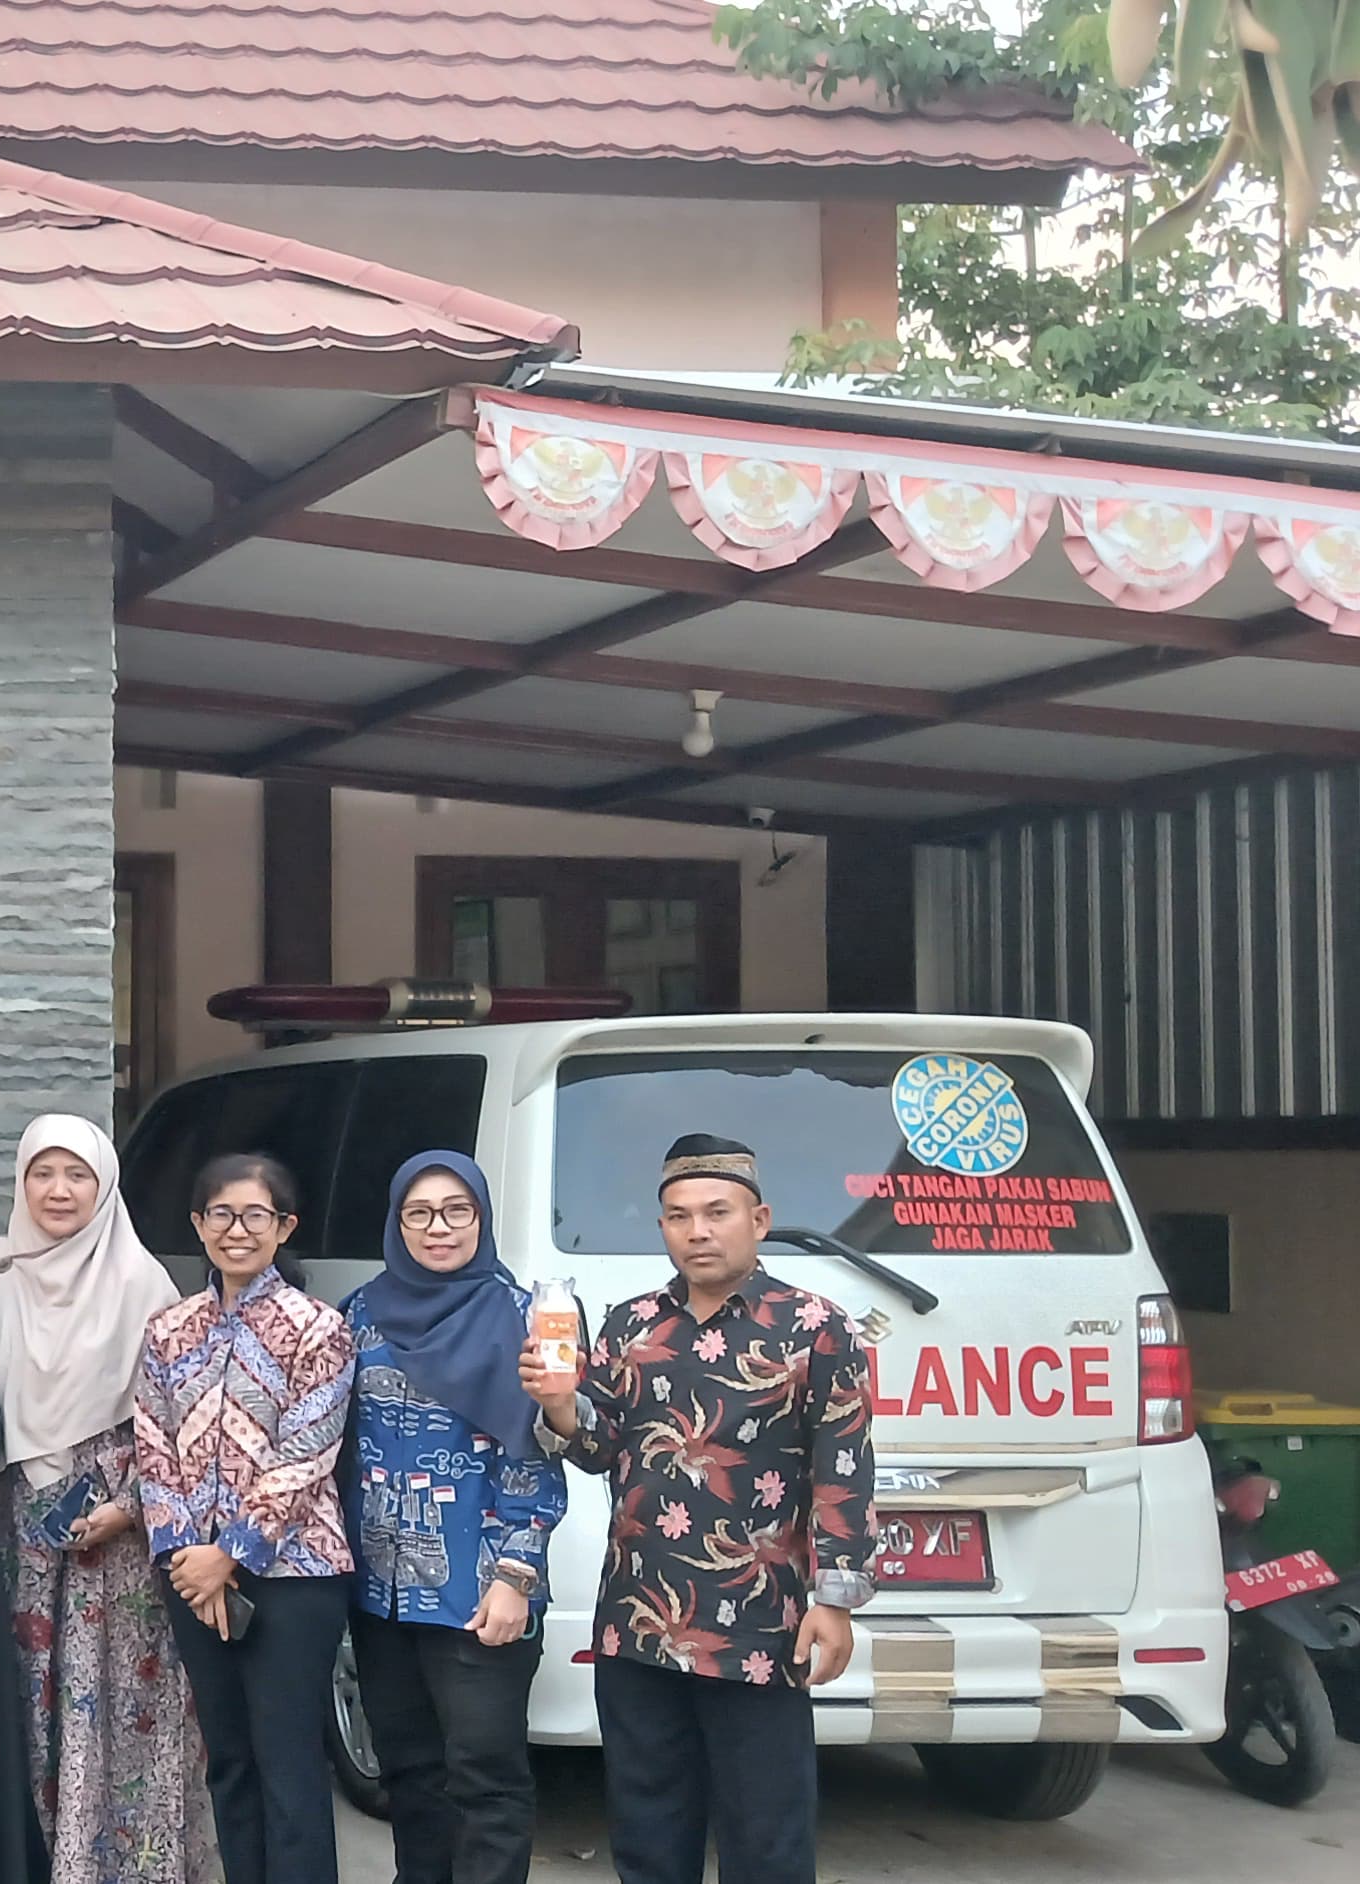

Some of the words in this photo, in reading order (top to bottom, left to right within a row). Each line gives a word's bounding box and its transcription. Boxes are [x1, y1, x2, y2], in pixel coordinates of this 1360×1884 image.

[899, 1058, 972, 1126] CEGAH
[915, 1070, 1008, 1158] CORONA
[955, 1102, 1022, 1171] VIRUS
[897, 1175, 980, 1199] TANGAN
[984, 1177, 1044, 1200] PAKAI
[1046, 1178, 1114, 1202] SABUN
[893, 1202, 993, 1226] GUNAKAN
[997, 1205, 1077, 1228] MASKER
[932, 1227, 985, 1250] JAGA
[989, 1229, 1055, 1251] JARAK
[863, 1346, 1113, 1417] LANCE
[921, 1518, 972, 1556] XF
[1239, 1561, 1287, 1586] 6372
